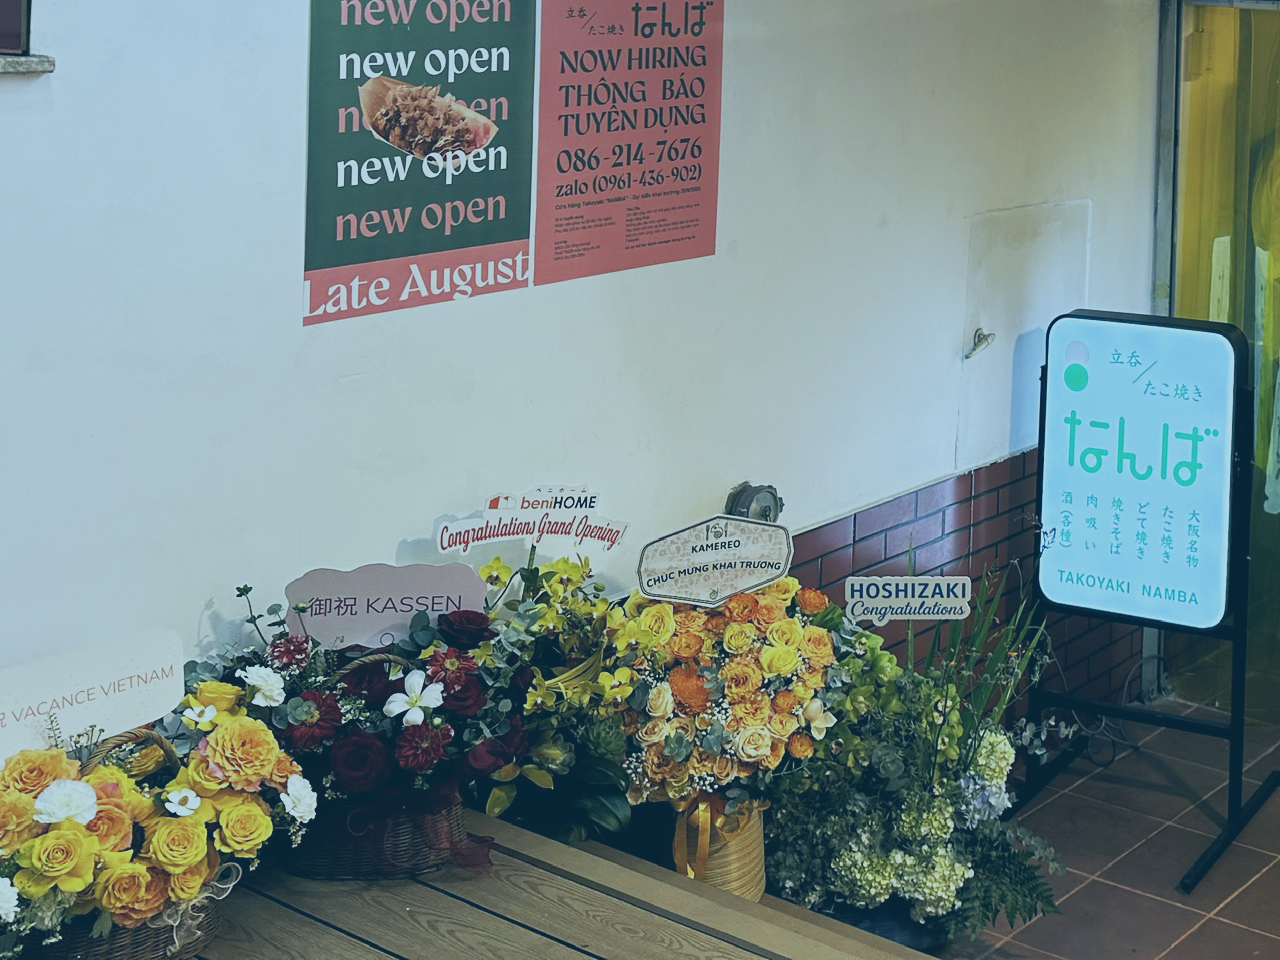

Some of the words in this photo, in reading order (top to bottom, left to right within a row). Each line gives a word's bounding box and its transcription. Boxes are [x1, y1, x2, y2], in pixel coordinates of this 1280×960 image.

[340, 0, 417, 26] new
[631, 1, 713, 38] なんば
[339, 50, 416, 80] new
[424, 46, 510, 83] open
[560, 49, 622, 73] NOW
[627, 45, 706, 70] HIRING
[559, 77, 647, 107] THÔNG
[662, 72, 705, 100] BÁO
[644, 104, 706, 133] DỤNG
[337, 154, 413, 187] new
[422, 146, 507, 184] open
[556, 137, 702, 174] 086-214-7676
[555, 179, 589, 198] zalo
[593, 163, 702, 194] (0961-436-902)
[336, 207, 412, 240] new
[421, 195, 506, 235] open
[303, 276, 391, 318] Late
[399, 250, 530, 301] August
[1109, 348, 1143, 367] 立呑
[1143, 380, 1203, 402] たこ焼き
[1064, 410, 1219, 487] なんば
[520, 496, 597, 510] beniHOME
[440, 517, 536, 552] Congratulations
[537, 513, 577, 543] Grand
[575, 515, 628, 551] Opening!
[1110, 497, 1124, 556] 焼きそば
[1135, 501, 1150, 560] どて焼き
[1160, 505, 1174, 564] たこ焼き
[1186, 509, 1201, 569] 大阪名物
[691, 540, 741, 553] KAMEREO
[712, 561, 737, 570] KHAI
[850, 583, 966, 598] HOSHIZAKI
[1057, 569, 1131, 594] TAKOYAKI
[1142, 584, 1199, 605] NAMBA
[307, 596, 358, 617] 御祝
[366, 595, 462, 614] KASSEN
[850, 600, 965, 622] Congratulations
[12, 687, 96, 722] VACANCE
[100, 665, 174, 696] VIETNAM
